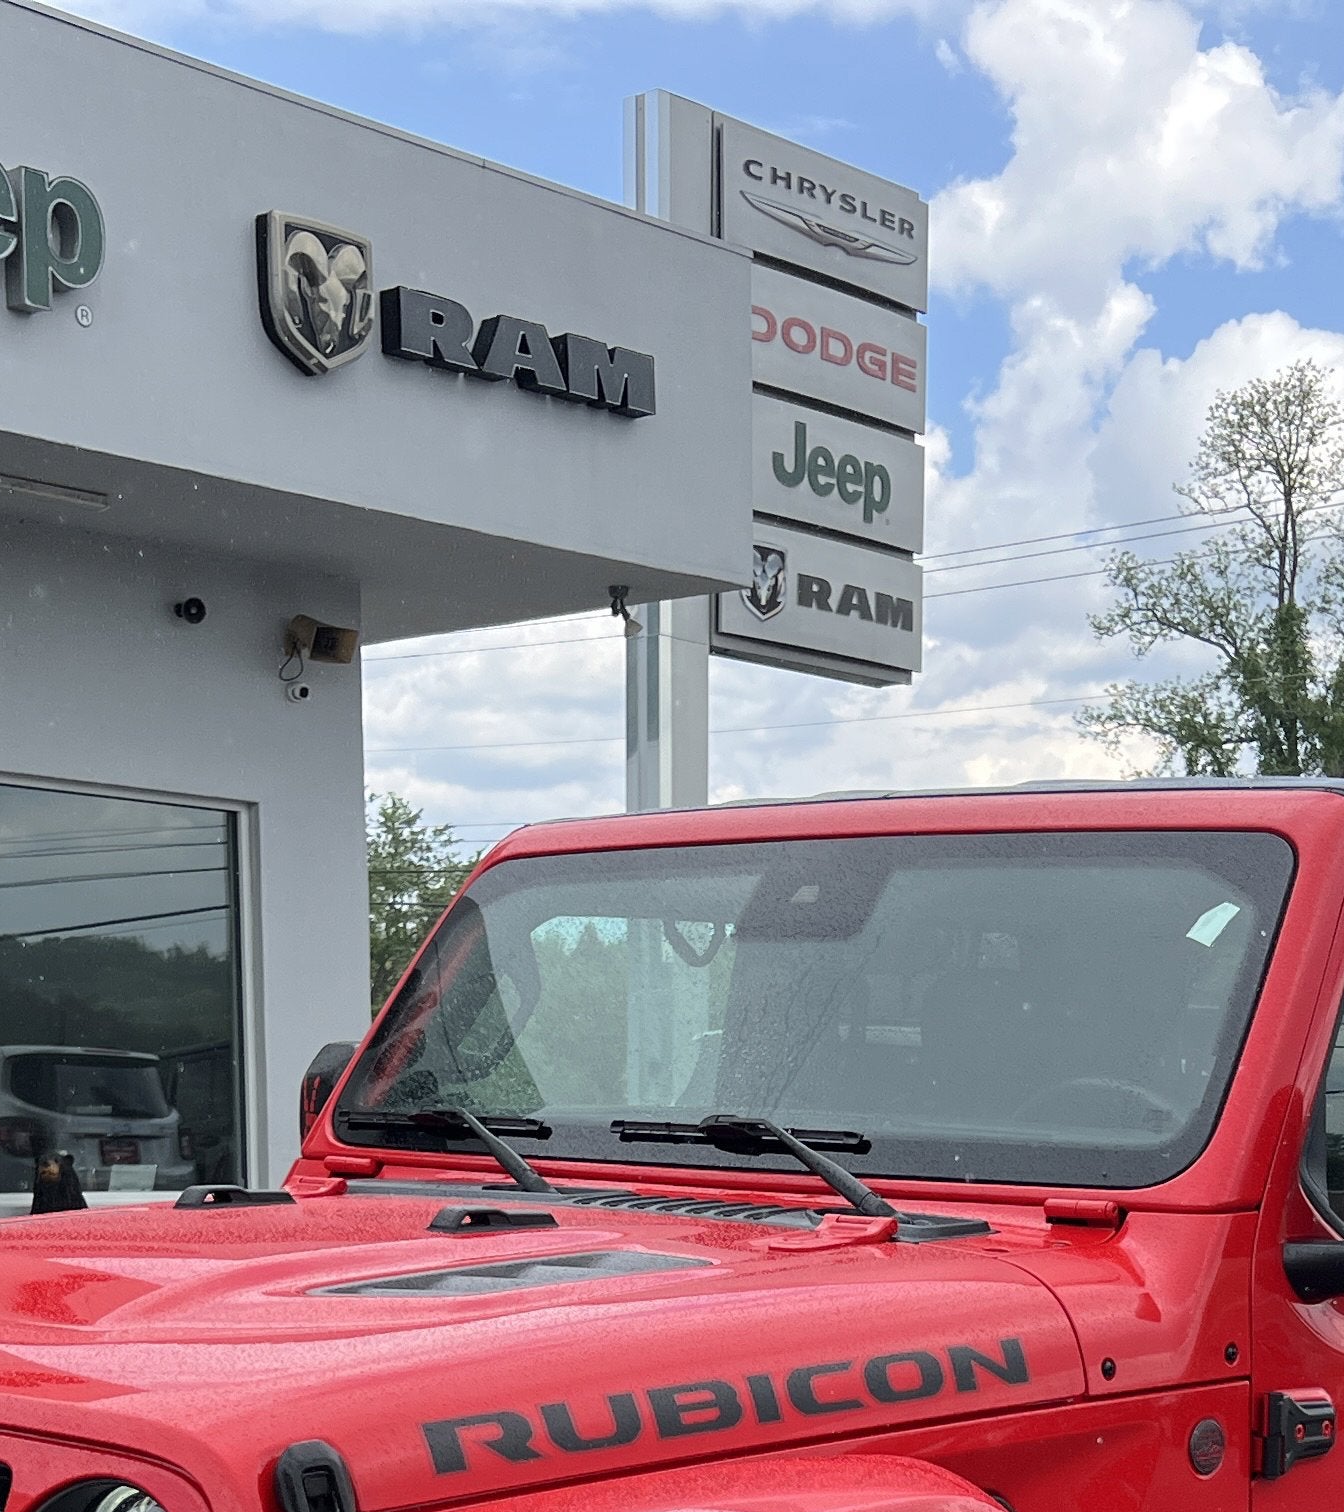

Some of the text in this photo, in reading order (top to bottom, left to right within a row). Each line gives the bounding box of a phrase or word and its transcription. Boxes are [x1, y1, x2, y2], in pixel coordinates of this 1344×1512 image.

[742, 158, 915, 241] CHRYSLER
[380, 286, 655, 418] RAM
[752, 305, 917, 393] DODGE
[772, 421, 891, 523] Jeep
[797, 572, 914, 632] RAM
[422, 1337, 1031, 1476] RUBICON
